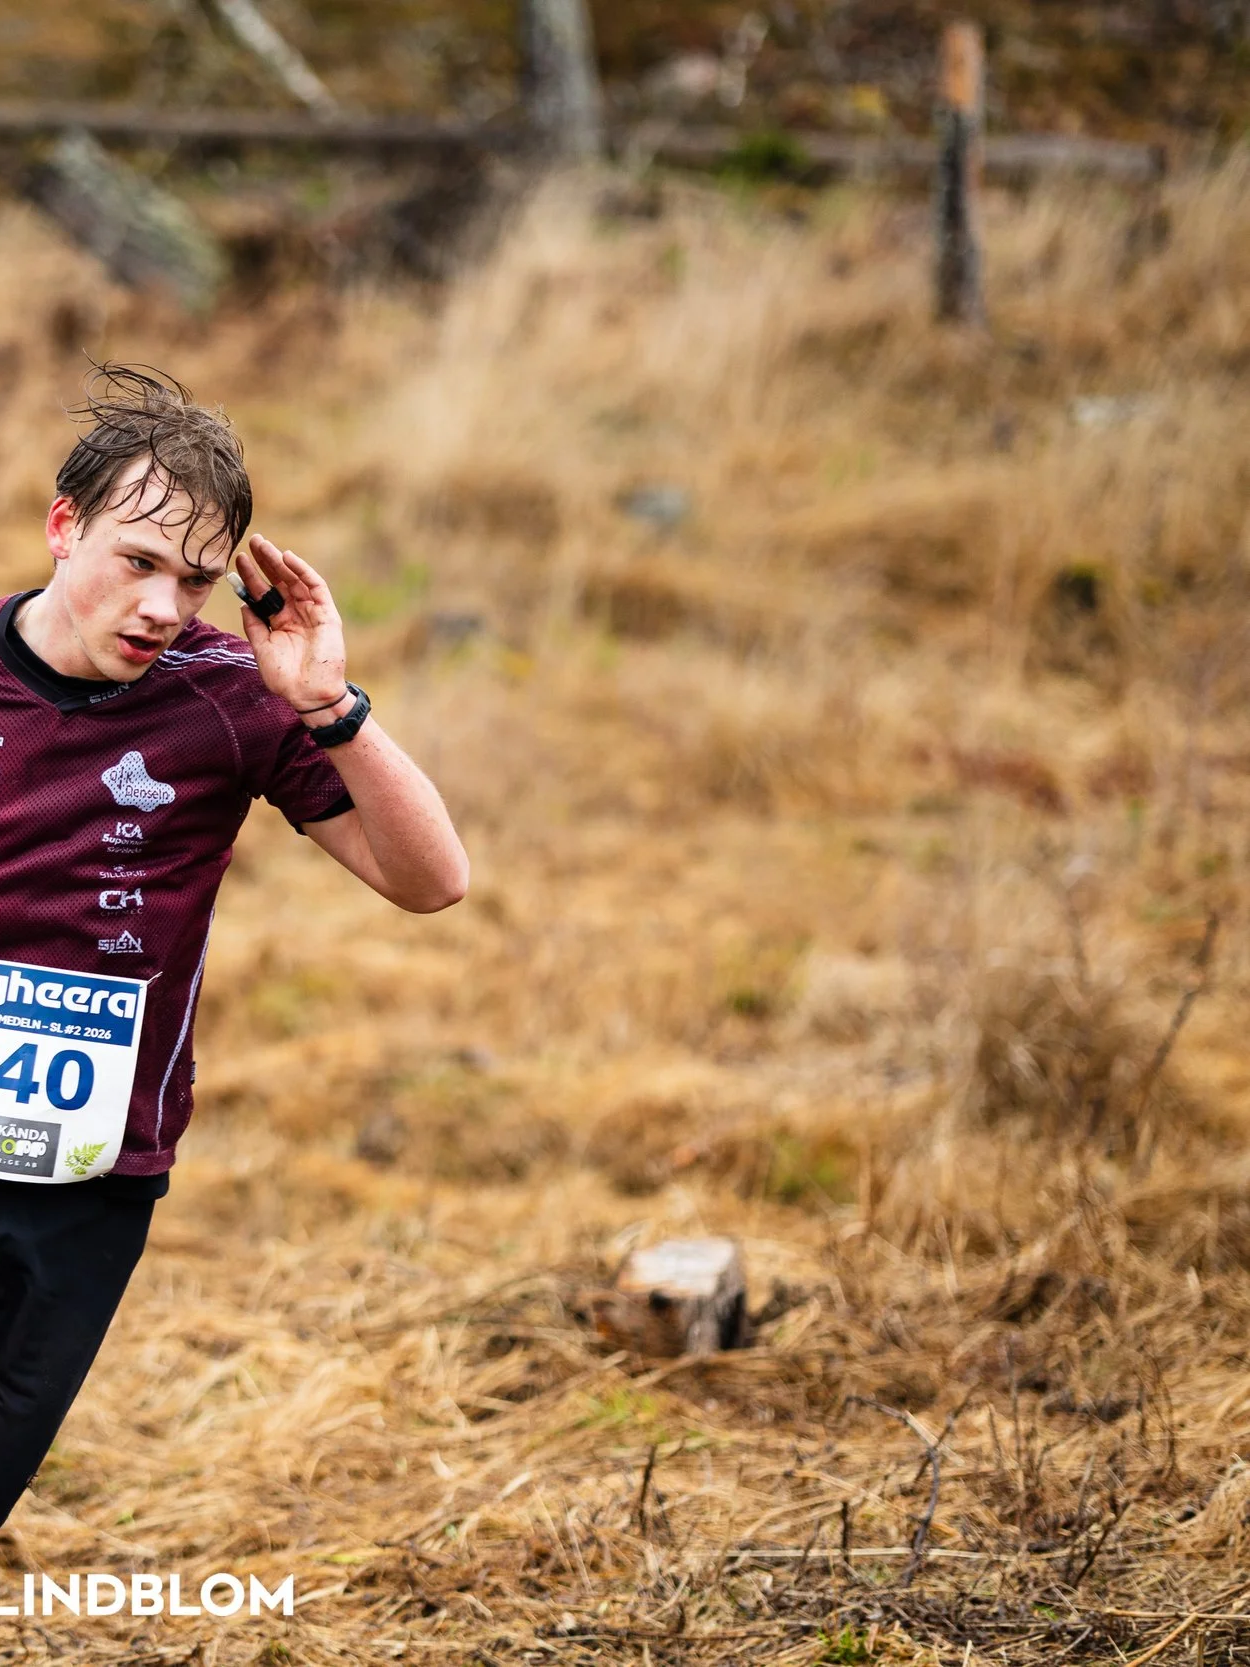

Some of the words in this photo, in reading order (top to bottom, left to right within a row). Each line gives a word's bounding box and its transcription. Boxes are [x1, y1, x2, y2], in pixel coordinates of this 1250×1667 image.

[115, 821, 143, 839] ICA
[50, 1022, 63, 1034] SL
[64, 1024, 81, 1036] #2
[83, 1027, 112, 1040] 2026
